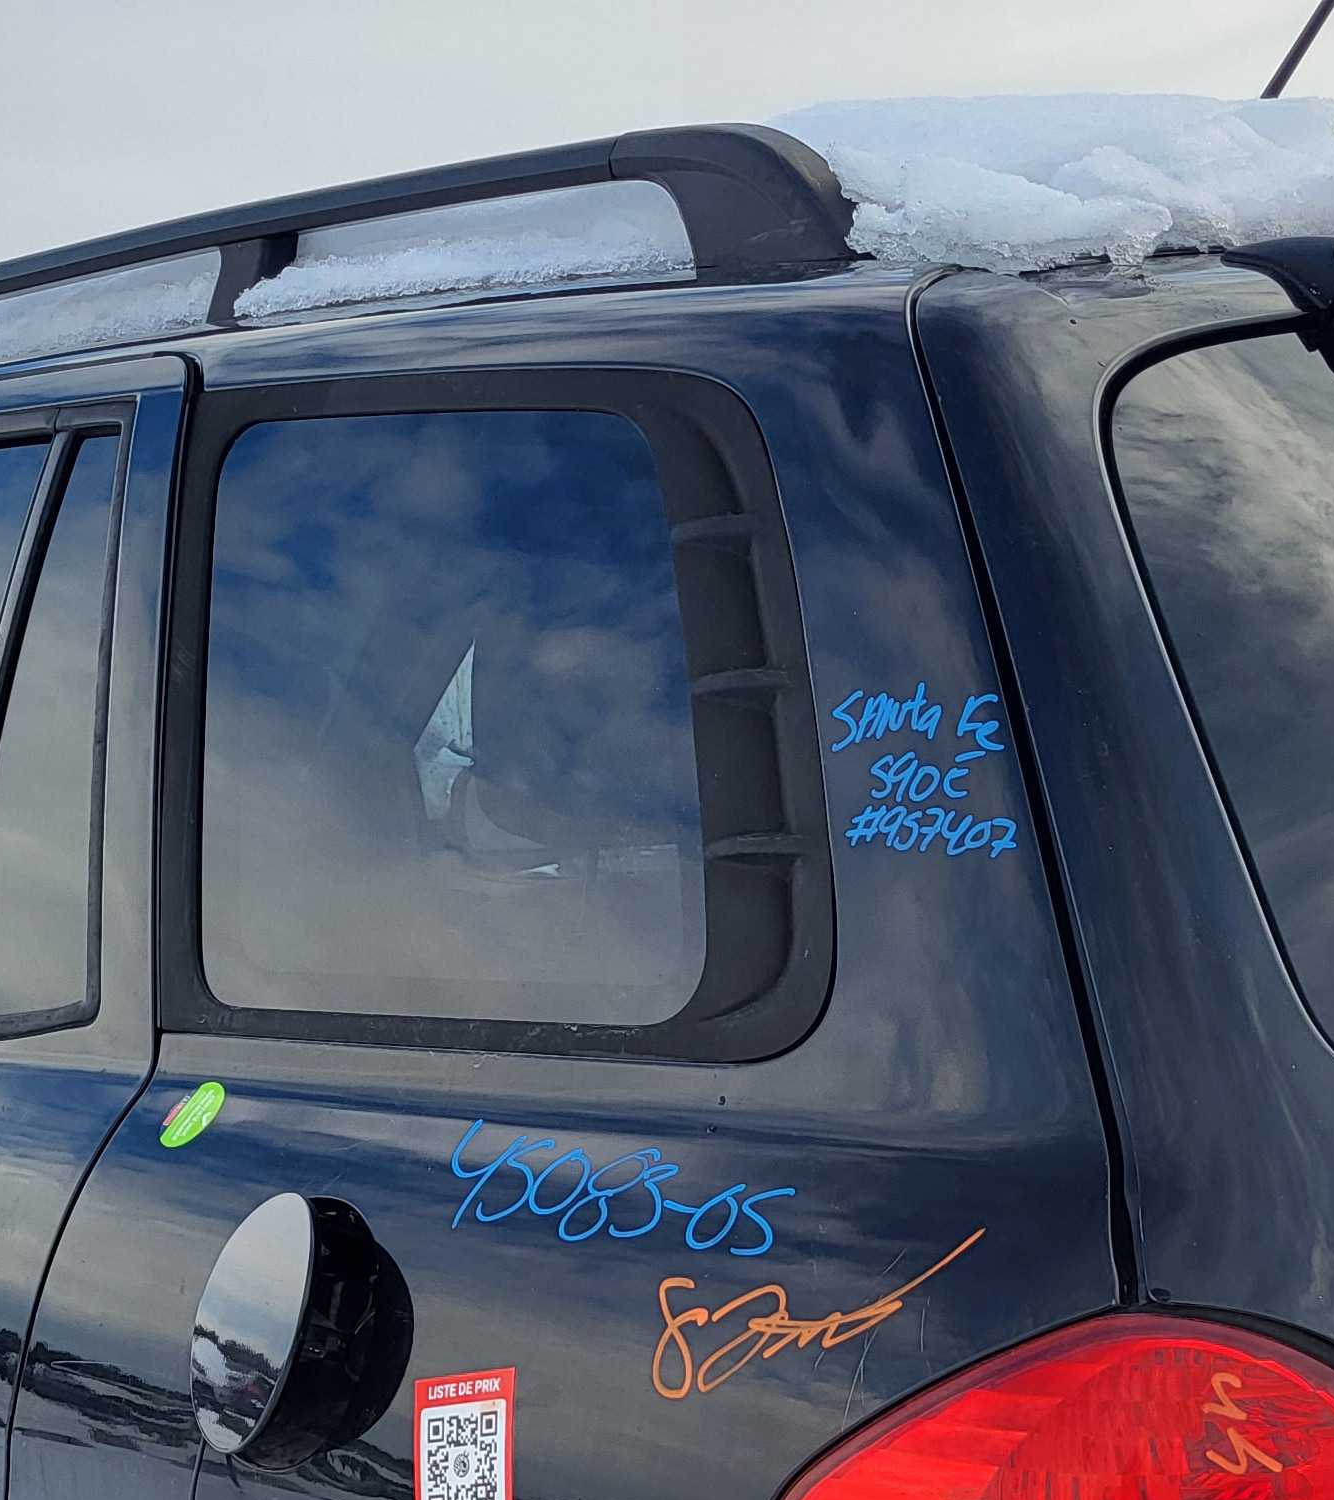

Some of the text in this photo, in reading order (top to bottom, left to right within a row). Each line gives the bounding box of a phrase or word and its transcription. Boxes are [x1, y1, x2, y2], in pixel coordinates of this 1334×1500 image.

[450, 1118, 797, 1257] 45083-05
[428, 1377, 501, 1400] LISTE DE PRIX
